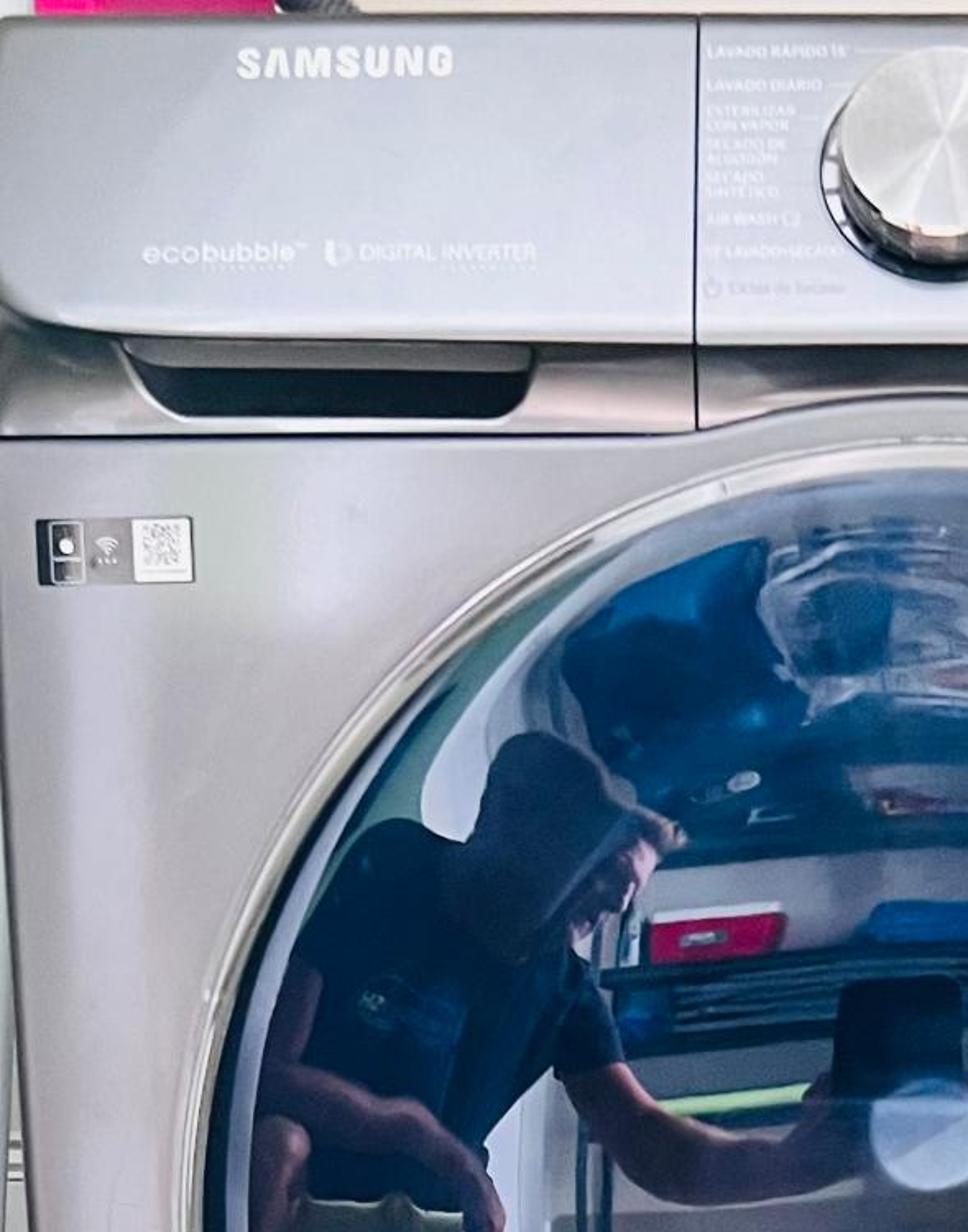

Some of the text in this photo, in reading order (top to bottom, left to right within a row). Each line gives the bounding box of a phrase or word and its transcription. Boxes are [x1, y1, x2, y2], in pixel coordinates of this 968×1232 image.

[706, 43, 767, 58] LAVADO
[236, 45, 454, 80] SAMSUNG
[706, 78, 766, 93] LAVADO
[142, 240, 295, 265] ecobubble
[358, 243, 537, 262] DIGITAL INVERTER
